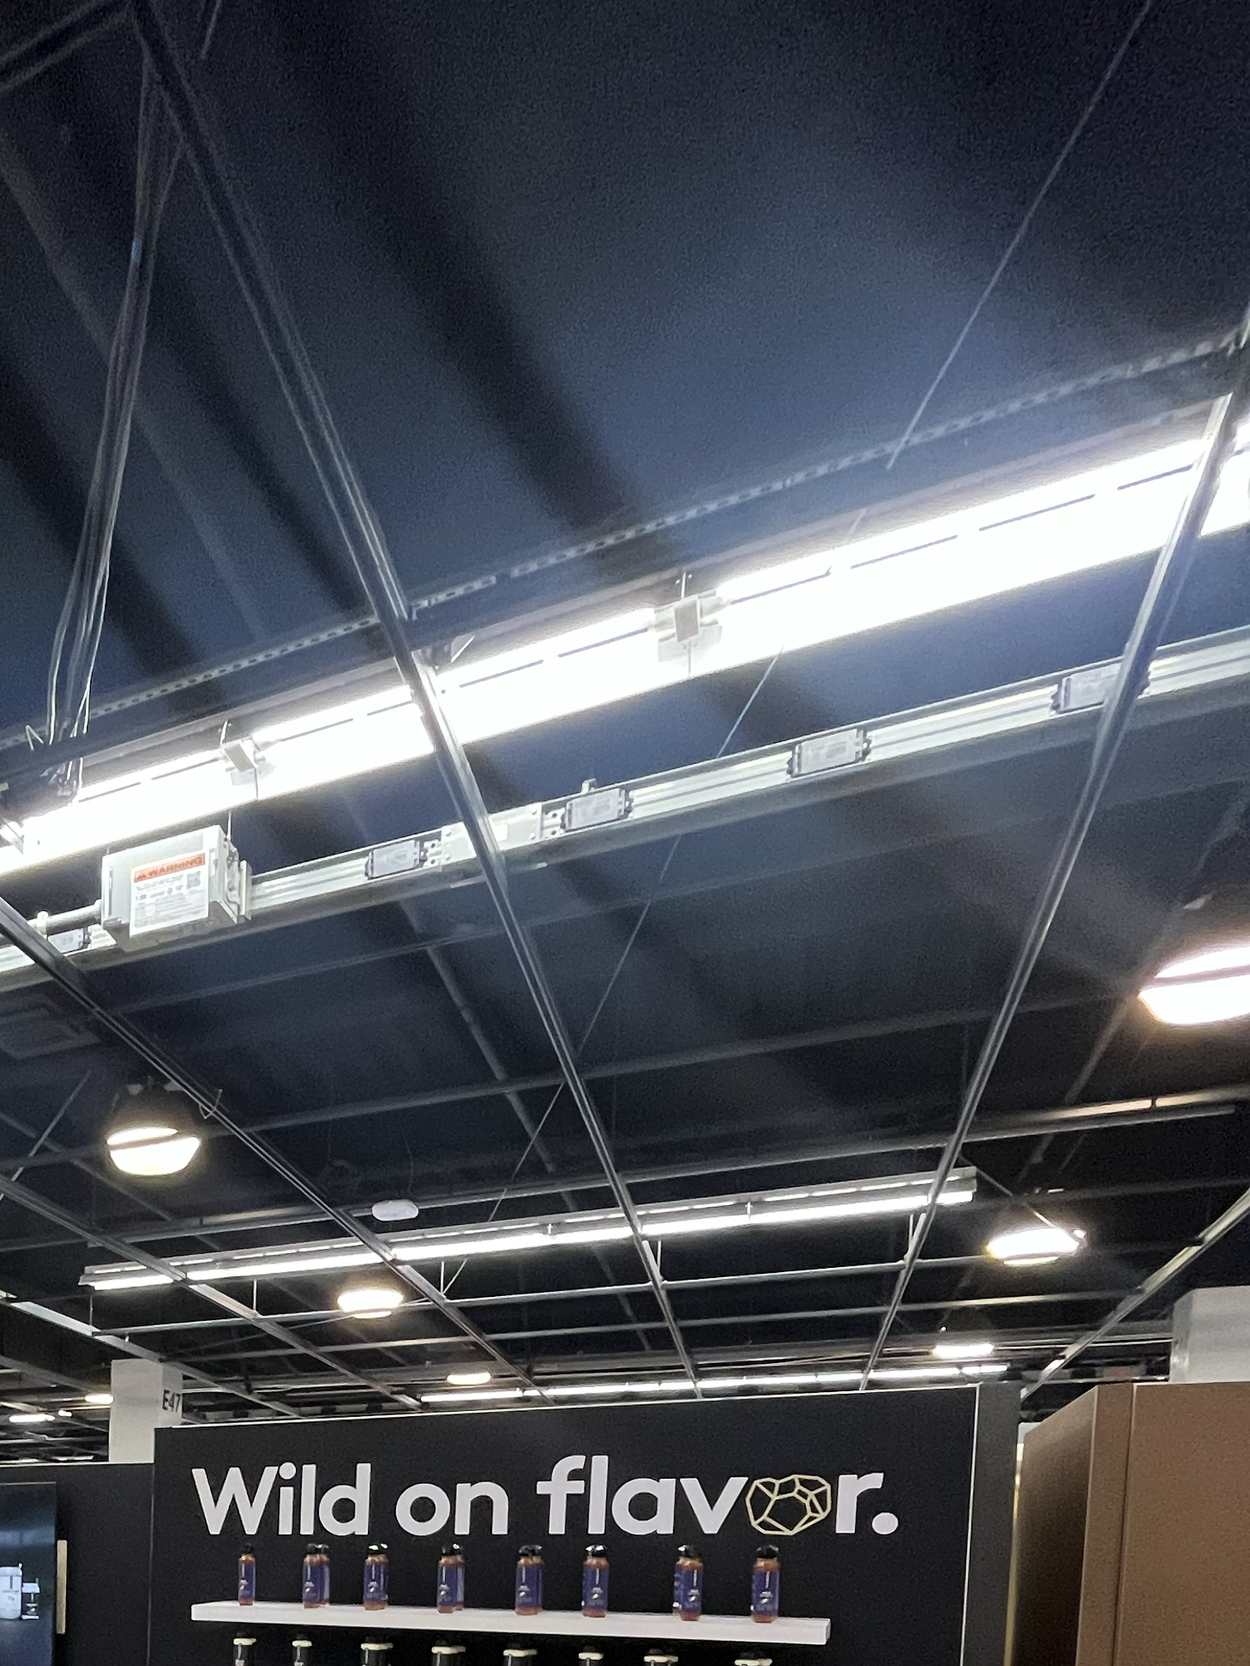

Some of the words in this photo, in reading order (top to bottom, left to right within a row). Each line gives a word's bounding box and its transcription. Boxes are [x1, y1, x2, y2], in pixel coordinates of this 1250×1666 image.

[149, 857, 203, 877] WARNING
[162, 1389, 181, 1413] E47
[191, 1462, 372, 1536] Wild
[395, 1481, 510, 1537] on
